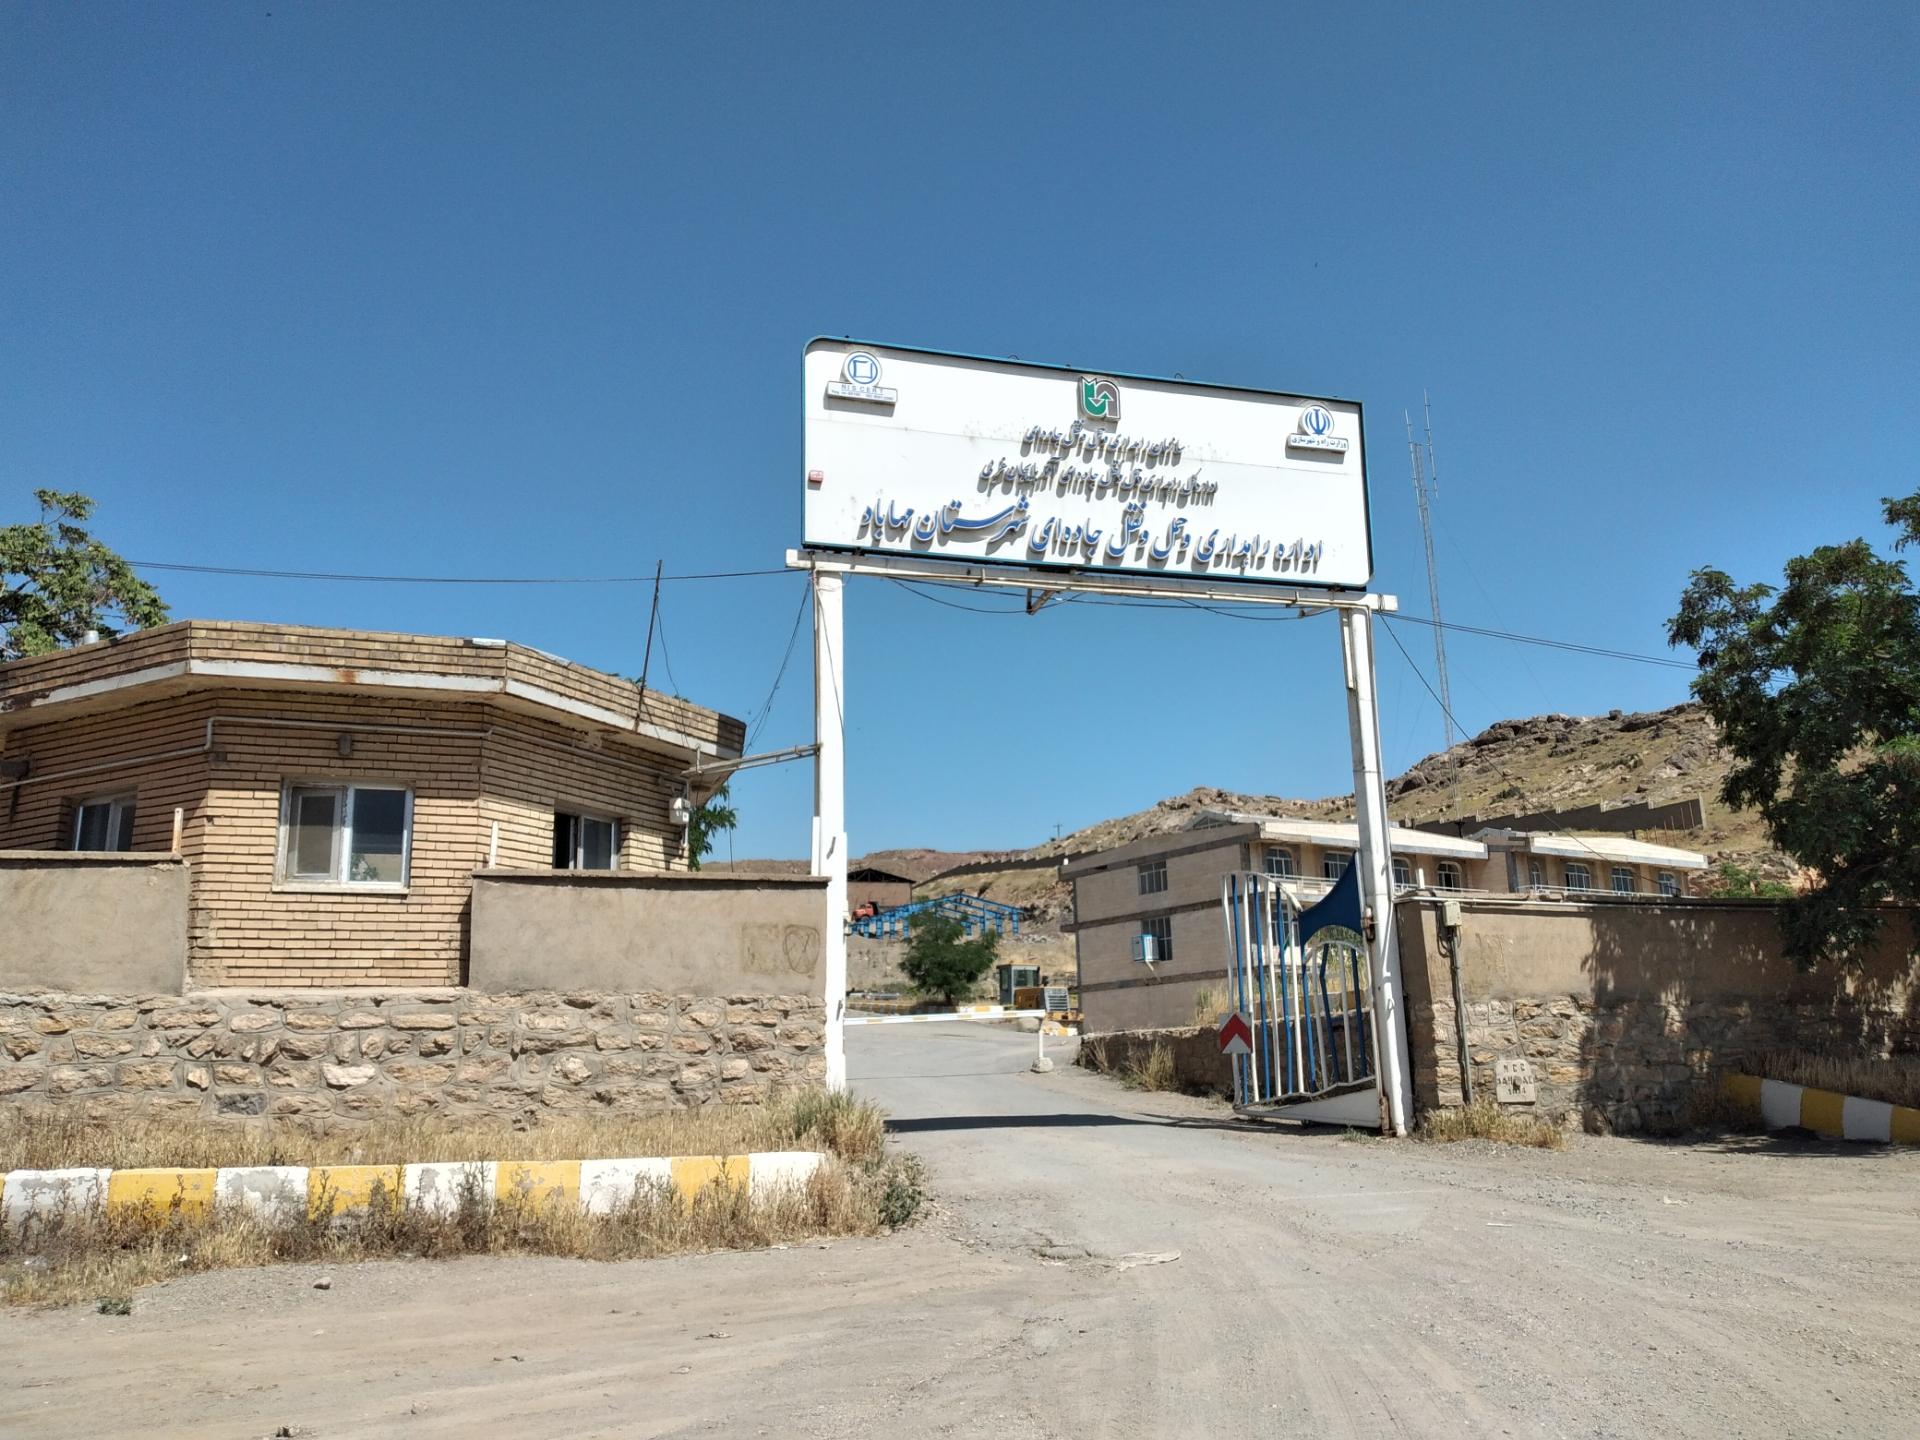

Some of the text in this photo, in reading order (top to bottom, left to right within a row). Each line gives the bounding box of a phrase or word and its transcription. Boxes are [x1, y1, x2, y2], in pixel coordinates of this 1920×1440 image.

[861, 497, 914, 540] مهاباد
[913, 495, 1031, 542] شهرستان
[1196, 528, 1271, 568] راهداری
[1276, 537, 1323, 560] اداره
